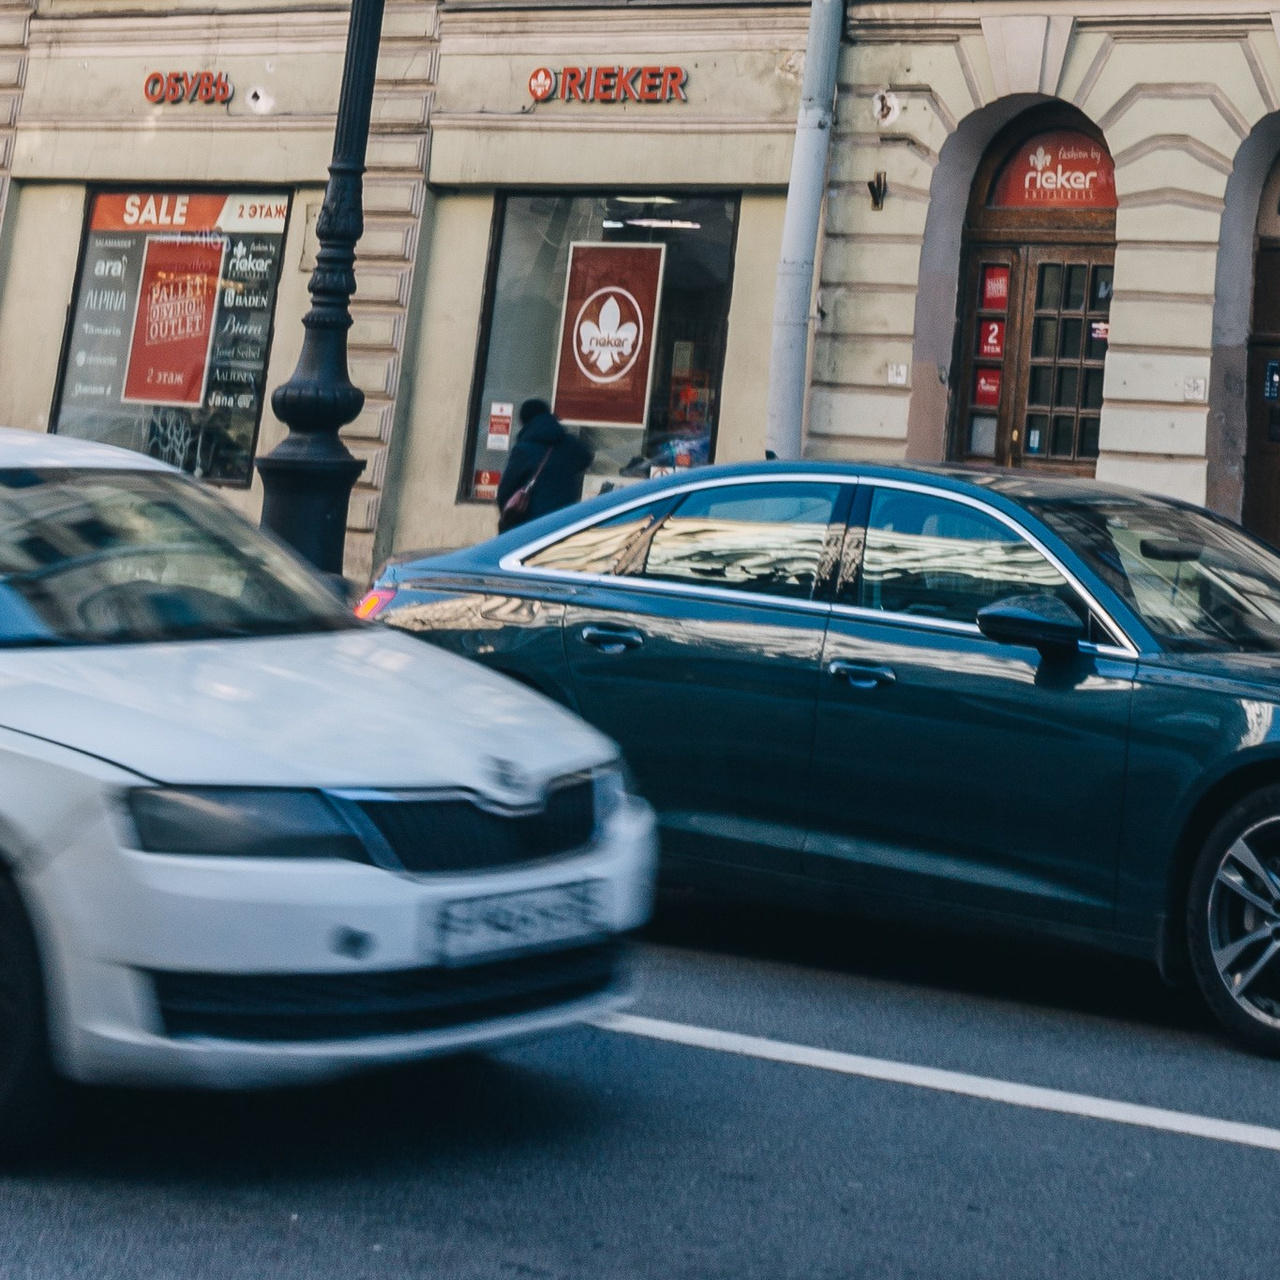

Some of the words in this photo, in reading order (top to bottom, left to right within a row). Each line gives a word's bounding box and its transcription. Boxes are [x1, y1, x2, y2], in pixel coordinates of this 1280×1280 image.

[144, 70, 232, 103] ОБУВЬ
[560, 66, 688, 102] RIEKER
[1024, 164, 1097, 190] rieker
[123, 194, 190, 226] SALE
[237, 204, 245, 219] 2
[248, 204, 287, 219] ЭТАЖ
[149, 316, 201, 339] OUTLET
[987, 322, 999, 344] 2
